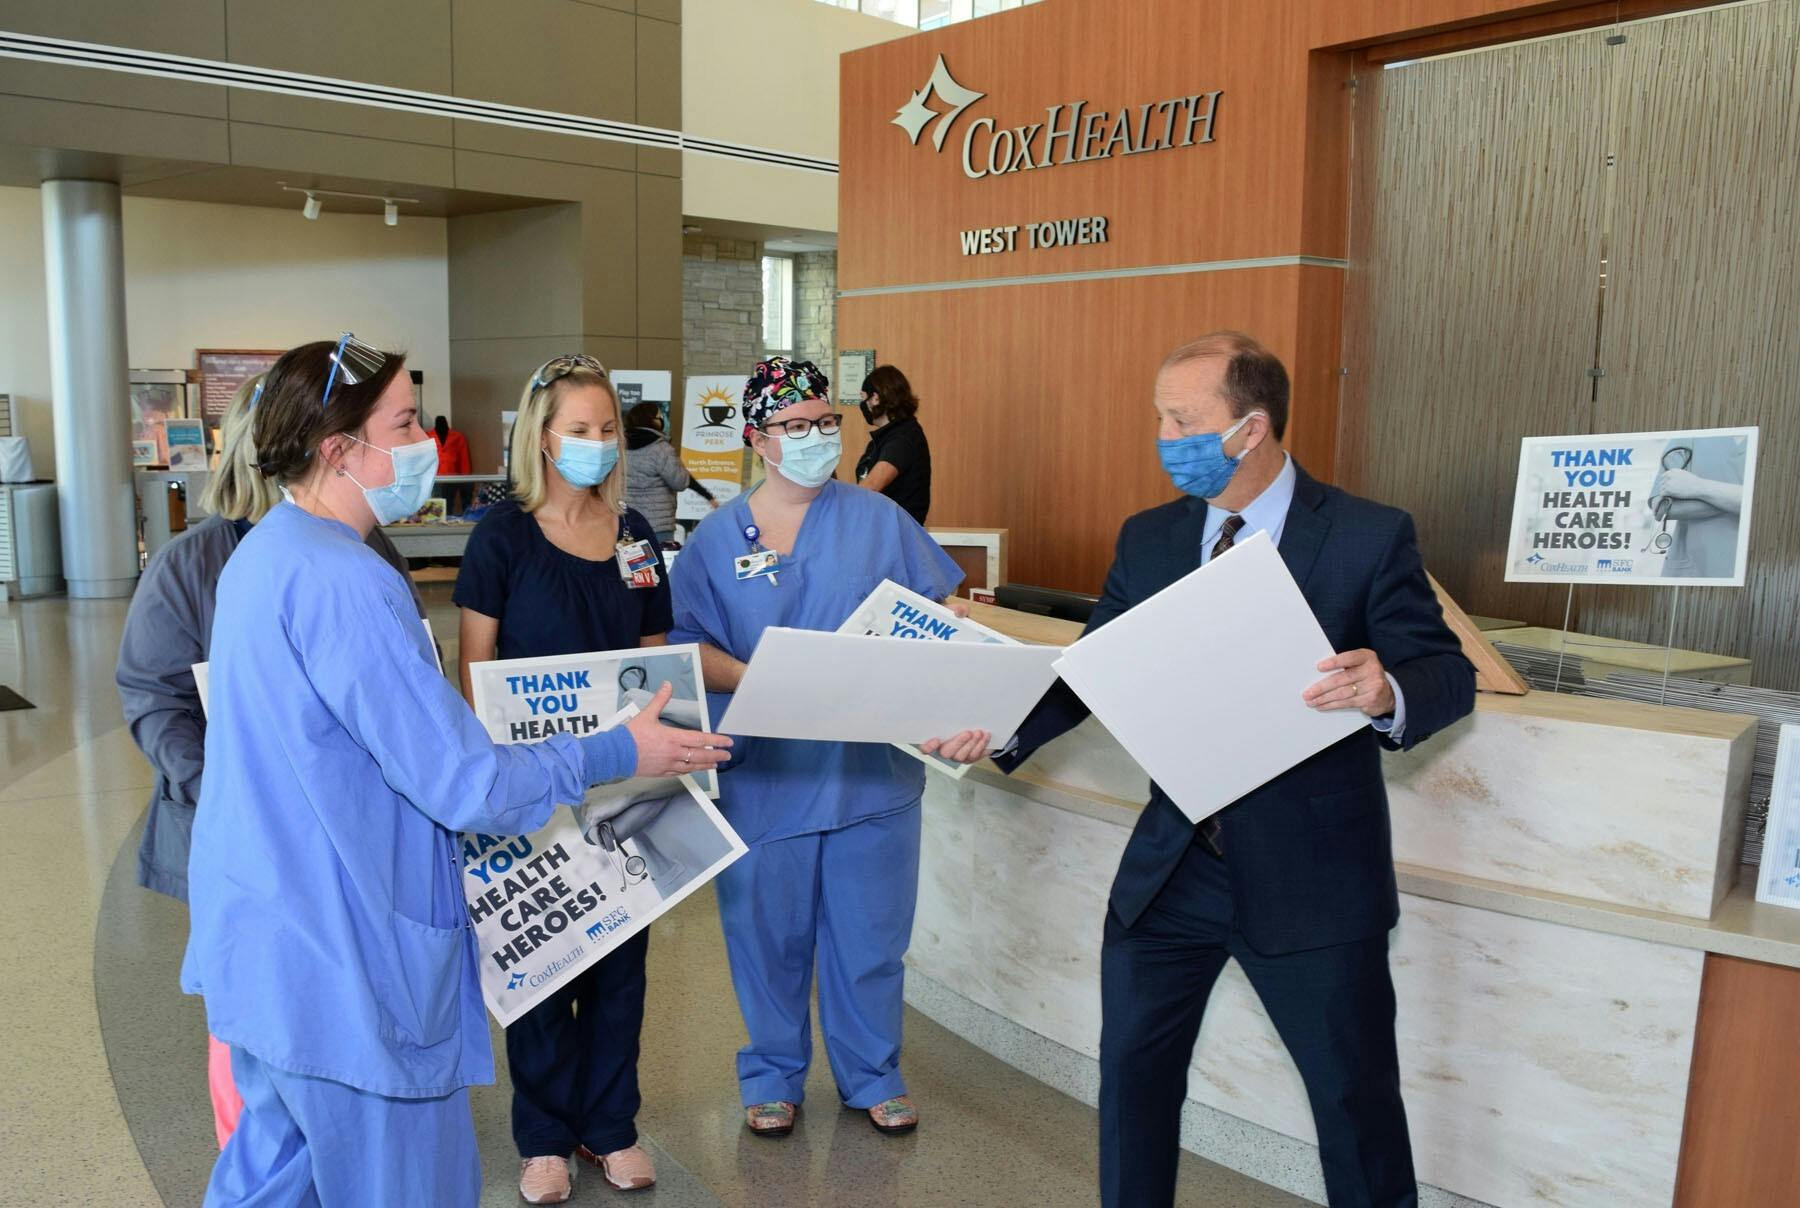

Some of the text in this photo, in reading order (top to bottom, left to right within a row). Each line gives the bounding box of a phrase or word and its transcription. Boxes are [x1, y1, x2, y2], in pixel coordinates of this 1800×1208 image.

[960, 215, 1108, 257] WEST TOWER
[1552, 448, 1632, 467] THANK
[723, 466, 738, 474] Shop
[1564, 469, 1616, 488] YOU
[1542, 490, 1632, 509] HEALTH
[1555, 511, 1614, 529] CARE
[1532, 532, 1632, 550] HEROES!
[891, 601, 958, 640] THANK
[506, 670, 592, 695] THANK
[525, 693, 578, 715] YOU
[510, 714, 599, 741] HEALTH
[468, 834, 533, 885] YOU
[468, 842, 571, 925] HEALTH
[500, 875, 572, 932] CARE
[491, 881, 607, 972] HEROES!
[603, 905, 626, 926] SFC
[607, 913, 632, 932] BANK
